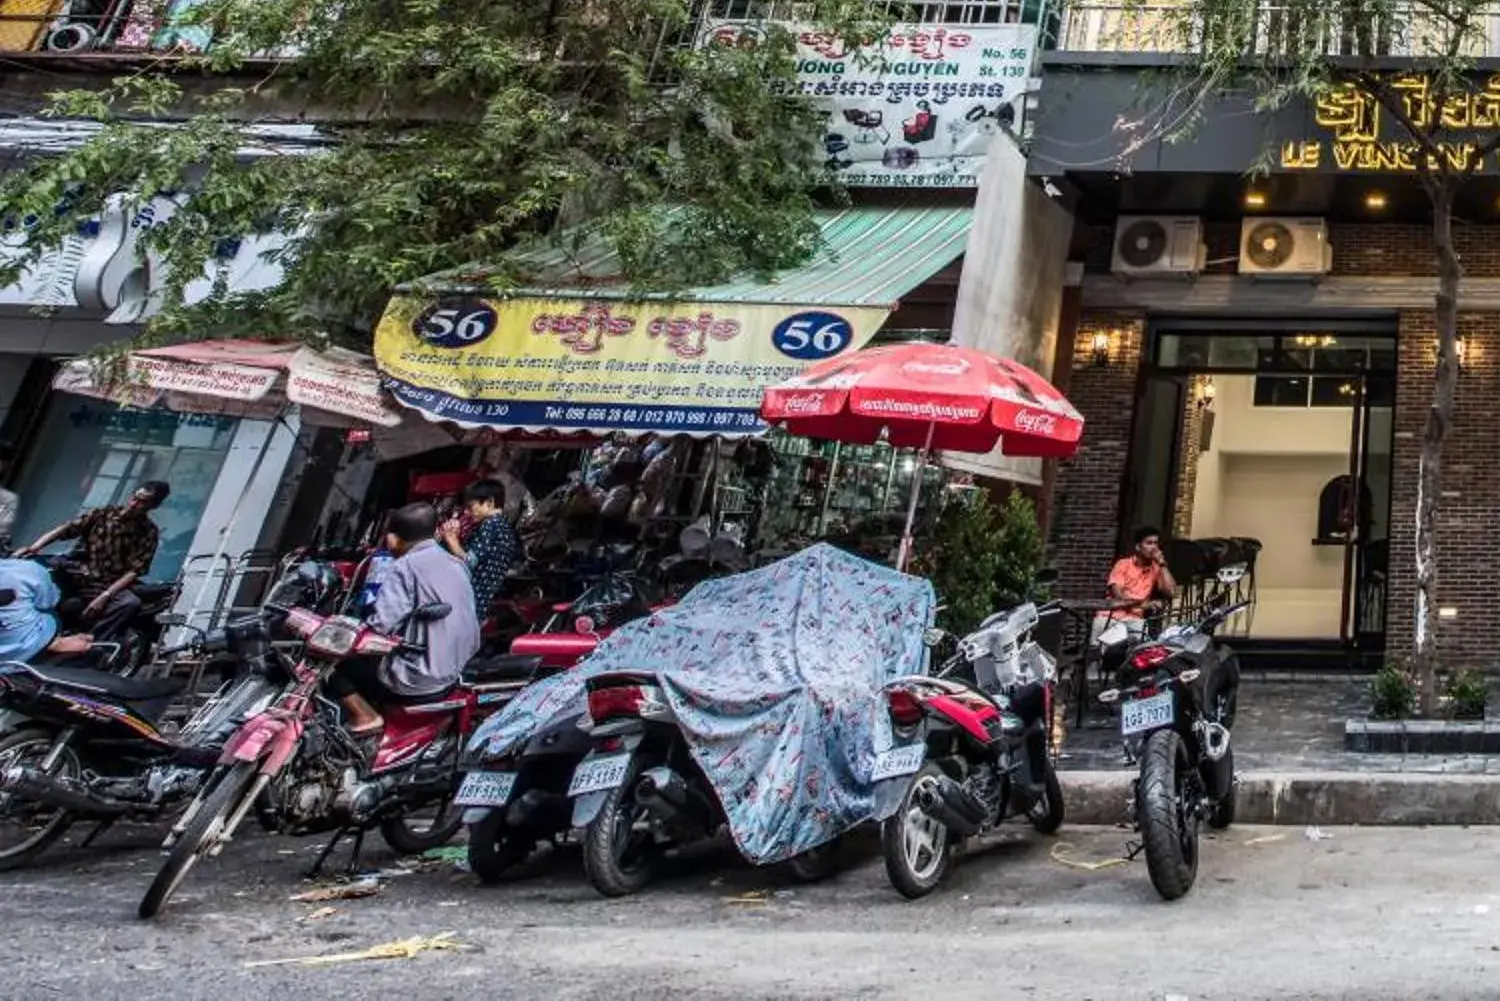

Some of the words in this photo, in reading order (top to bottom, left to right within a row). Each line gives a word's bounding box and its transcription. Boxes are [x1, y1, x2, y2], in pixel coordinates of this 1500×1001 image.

[1280, 141, 1321, 169] LE
[422, 310, 488, 340] 56
[780, 320, 845, 352] 56
[544, 406, 565, 419] Tel:
[645, 410, 664, 423] 012
